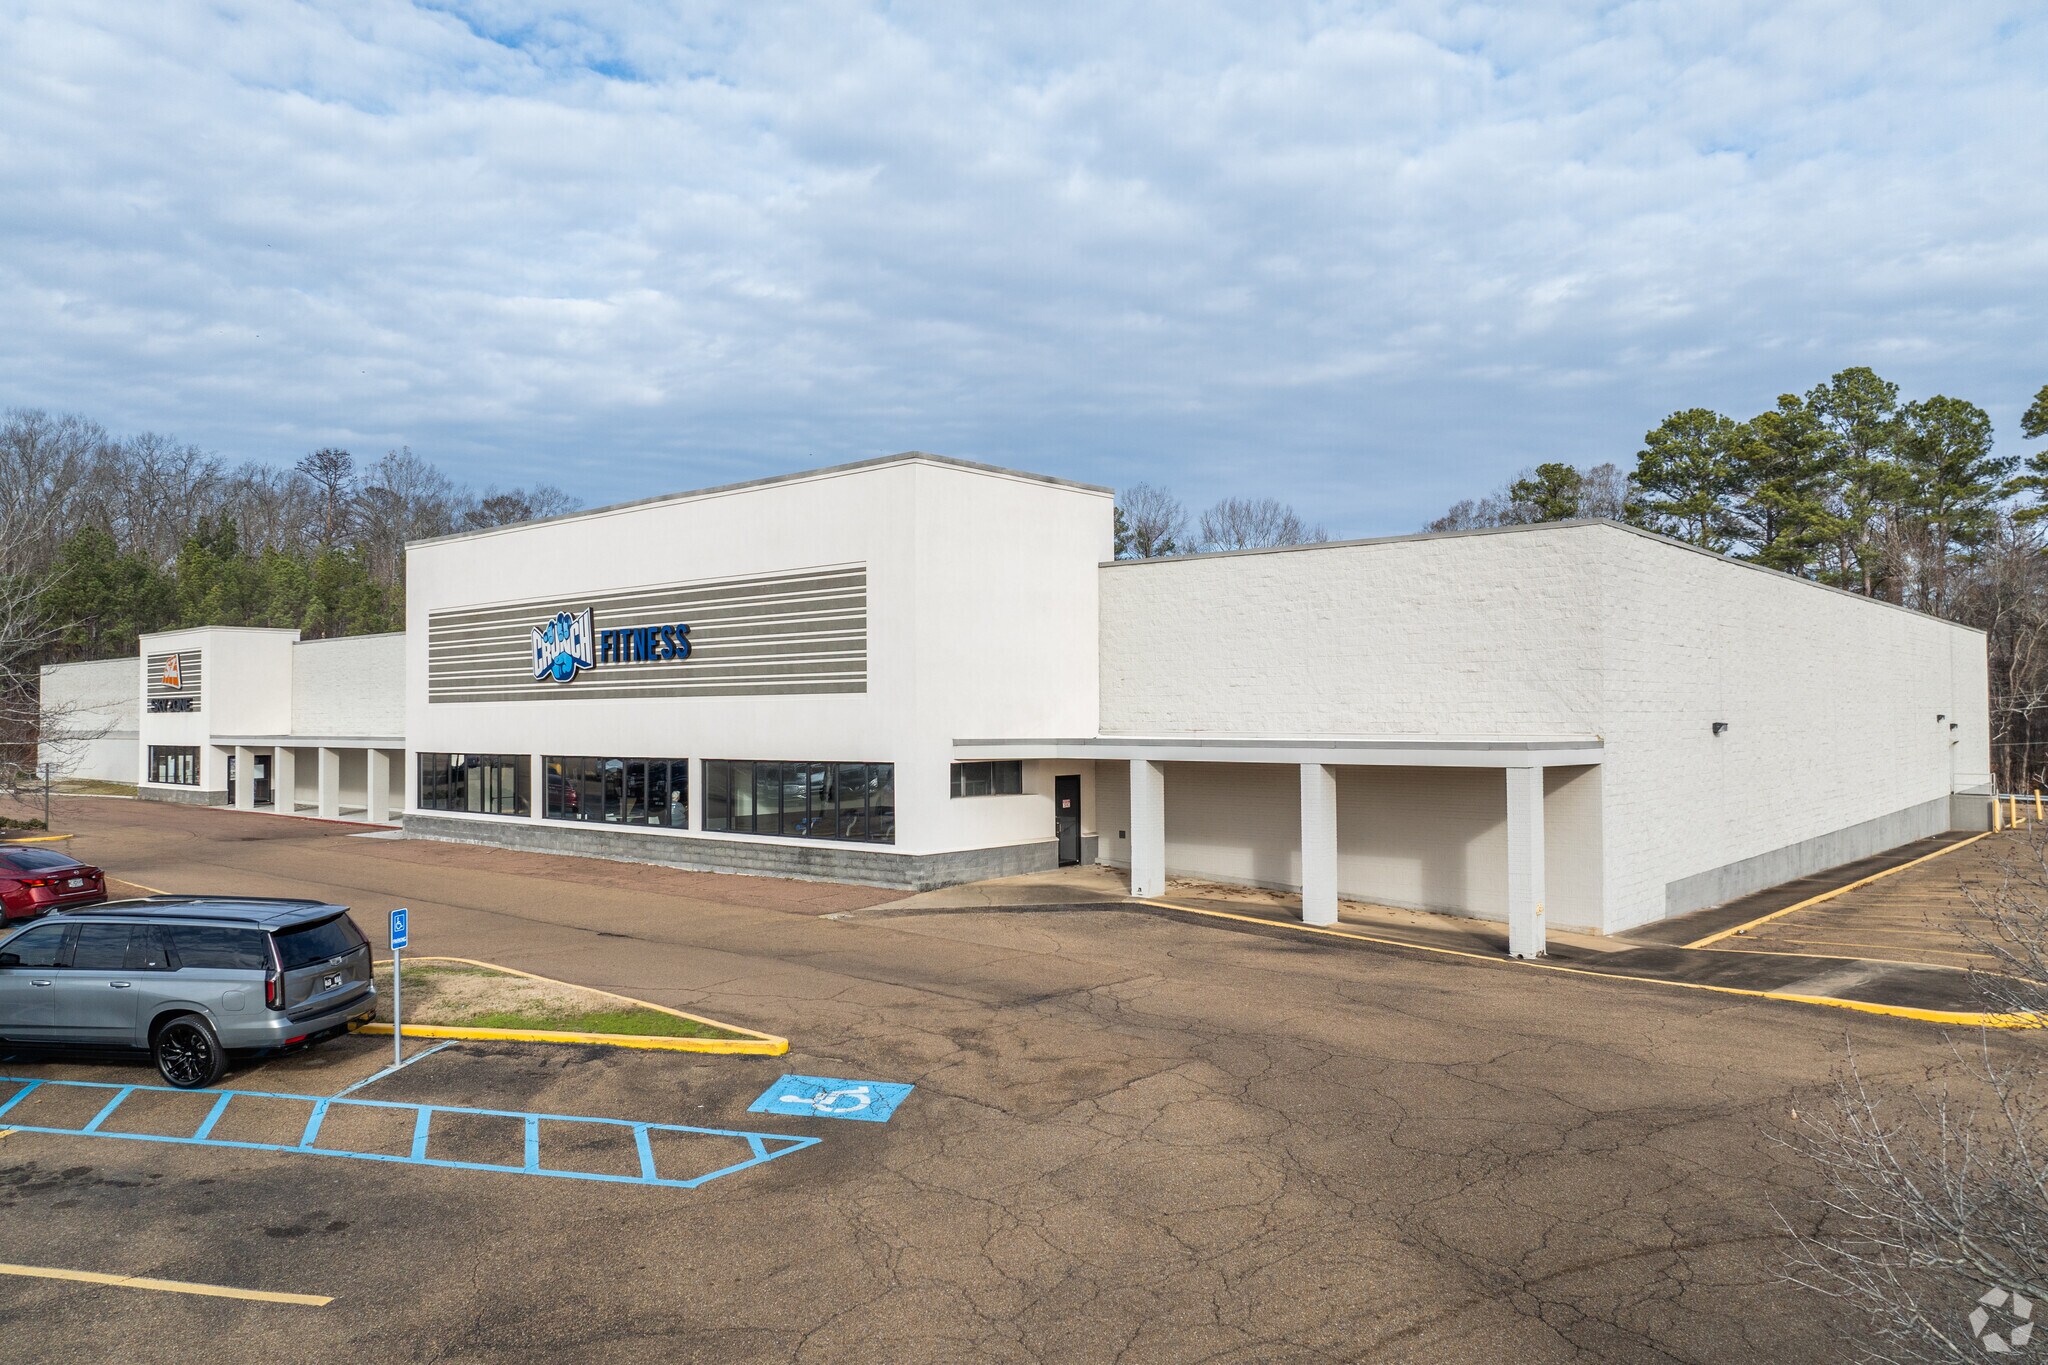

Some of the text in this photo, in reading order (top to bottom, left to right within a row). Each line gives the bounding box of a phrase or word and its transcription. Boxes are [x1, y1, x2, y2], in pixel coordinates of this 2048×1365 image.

[532, 611, 691, 678] CRUNCH FITNESS
[151, 698, 193, 712] SKY ZONE
